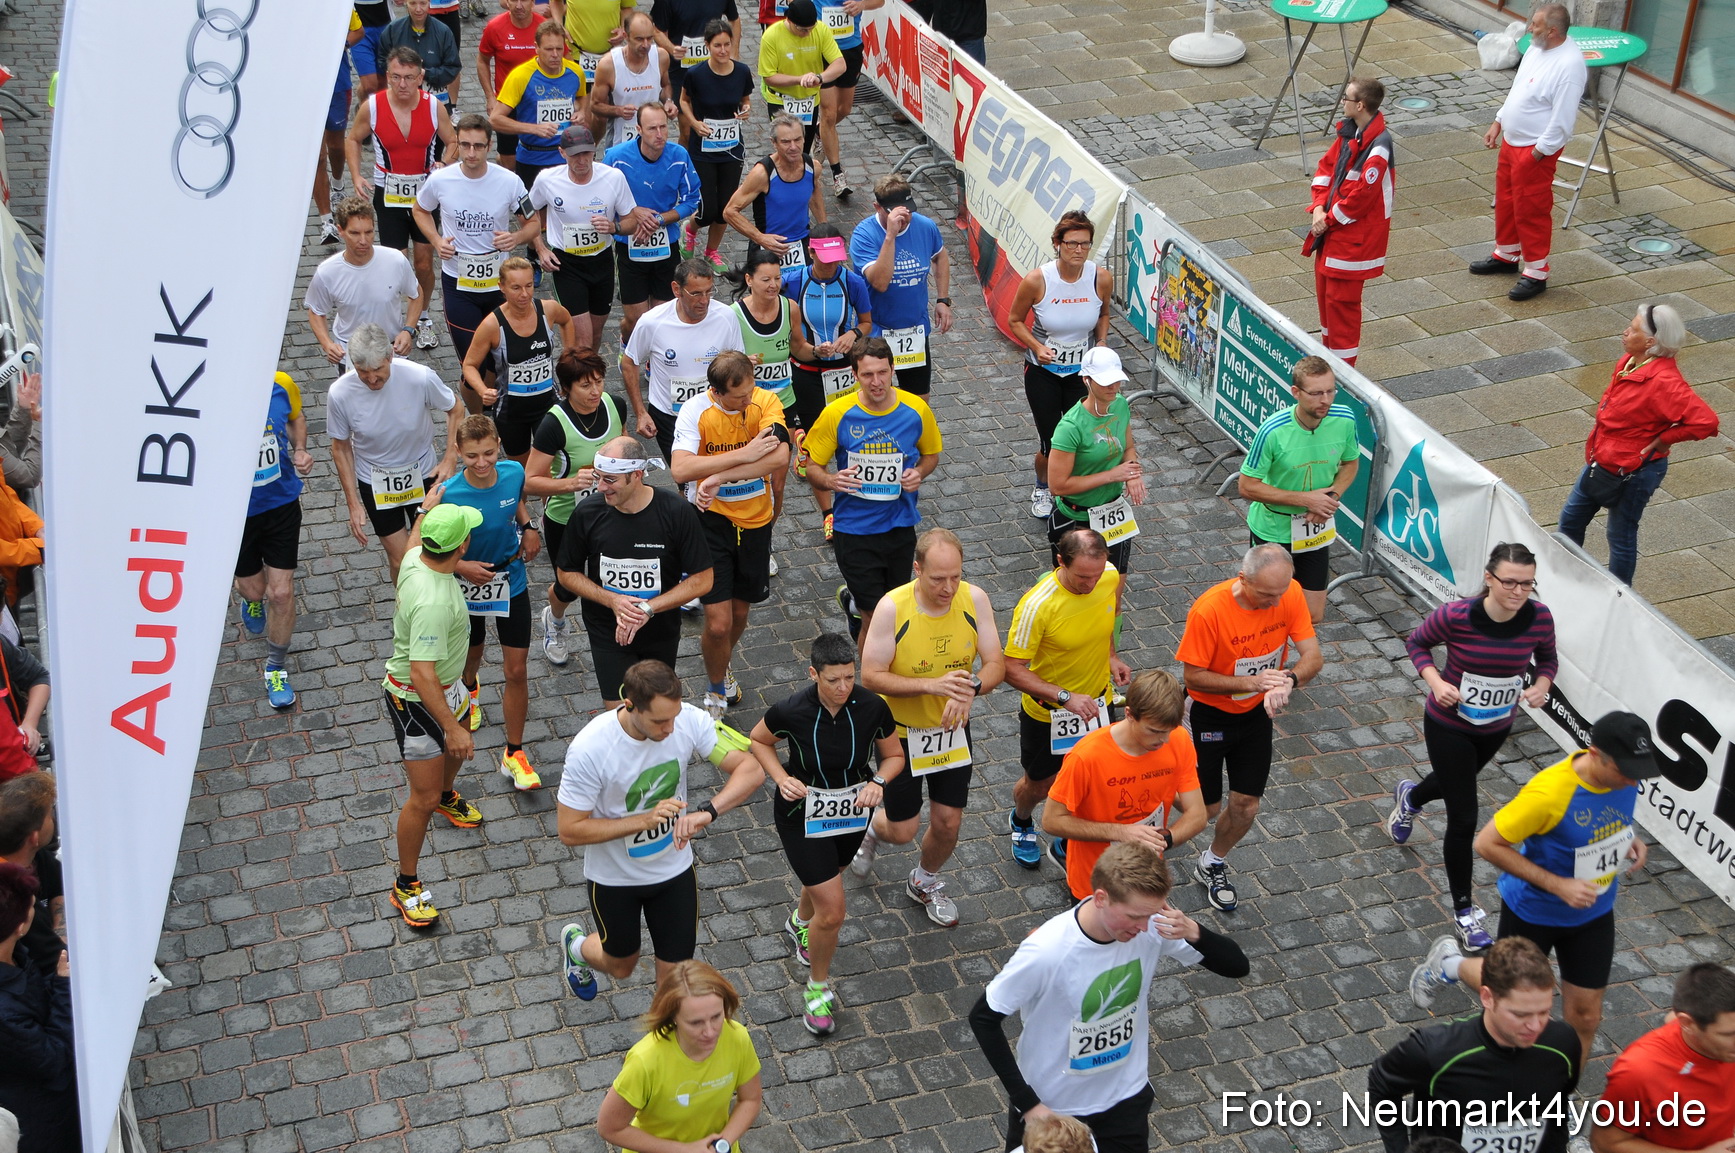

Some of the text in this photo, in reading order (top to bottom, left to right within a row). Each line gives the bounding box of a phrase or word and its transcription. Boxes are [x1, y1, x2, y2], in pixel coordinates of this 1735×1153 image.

[829, 14, 850, 27] 304
[901, 65, 921, 104] Braun
[541, 107, 572, 122] 2065
[787, 100, 813, 113] 2752
[394, 183, 417, 196] 161
[457, 220, 493, 229] Müller
[572, 231, 599, 246] 153
[573, 246, 600, 255] Johannes
[466, 263, 494, 279] 295
[897, 337, 914, 353] 12
[896, 356, 916, 364] Robert
[1056, 365, 1073, 373] Petra
[1223, 346, 1255, 387] Mehr
[512, 364, 550, 384] 2375
[754, 362, 788, 380] 2020
[1221, 372, 1239, 401] für
[1240, 388, 1258, 417] Ihr
[1219, 408, 1236, 429] Miet
[1236, 424, 1243, 438] &
[382, 473, 413, 492] 162
[853, 464, 898, 483] 2673
[384, 491, 414, 502] Bernhard
[724, 483, 755, 496] Matthias
[110, 281, 214, 756] Audi BKK
[1098, 506, 1126, 529] 185
[1108, 528, 1124, 539] Anke
[1304, 536, 1327, 548] Karsten
[601, 561, 620, 569] PARTL
[1379, 537, 1409, 567] Gebäude
[1409, 560, 1434, 584] Service
[1434, 578, 1456, 601] GmbH
[606, 569, 655, 589] 2596
[463, 583, 504, 601] 2237
[1464, 686, 1516, 707] 2900
[1551, 695, 1593, 748] verbinde
[920, 728, 954, 755] 277
[931, 754, 951, 766] Jockl
[822, 820, 851, 830] Kerstin
[1596, 848, 1619, 872] 44
[1072, 1012, 1130, 1034] PARTL Neumarkt
[1078, 1018, 1134, 1056] 2658
[1092, 1051, 1122, 1067] Marco
[1471, 1132, 1538, 1153] 2395
